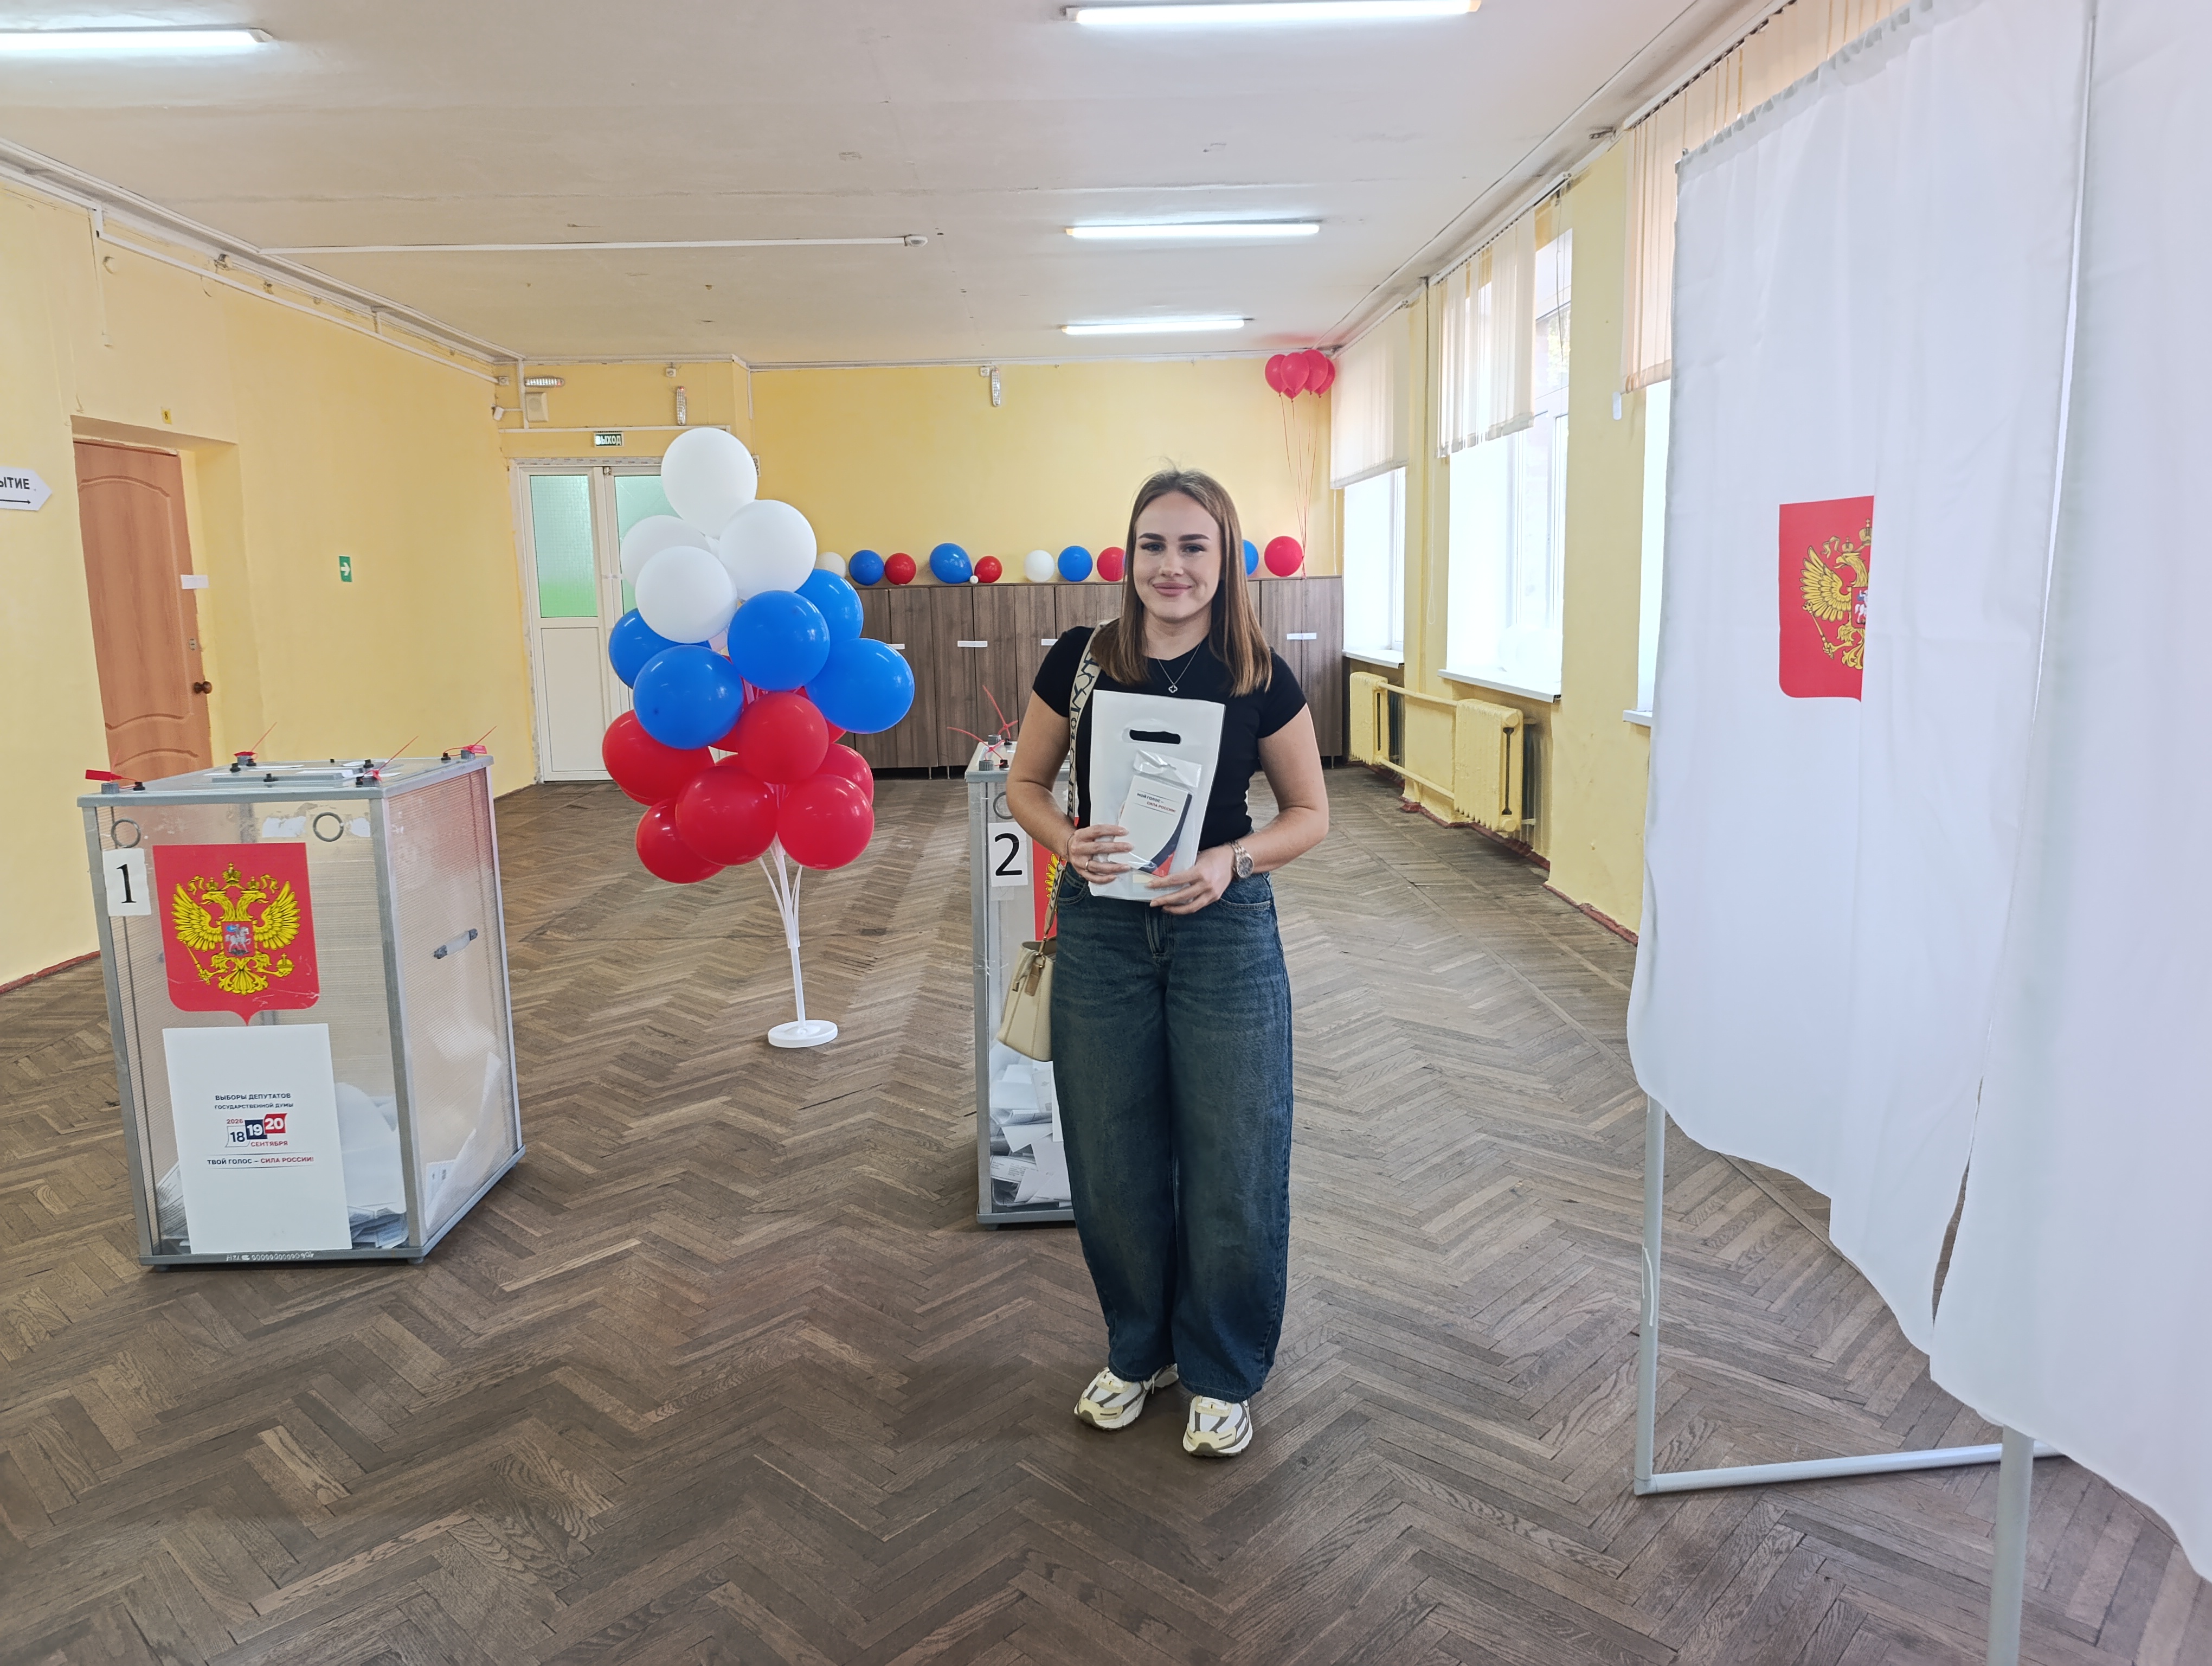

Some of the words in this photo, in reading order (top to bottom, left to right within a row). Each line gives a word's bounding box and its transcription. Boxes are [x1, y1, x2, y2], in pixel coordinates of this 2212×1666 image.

[164, 411, 168, 420] 8
[595, 435, 622, 445] ВЫХОД
[994, 832, 1023, 876] 2
[116, 863, 137, 904] 1
[230, 1131, 245, 1143] 18
[247, 1124, 263, 1136] 19
[265, 1117, 284, 1130] 20
